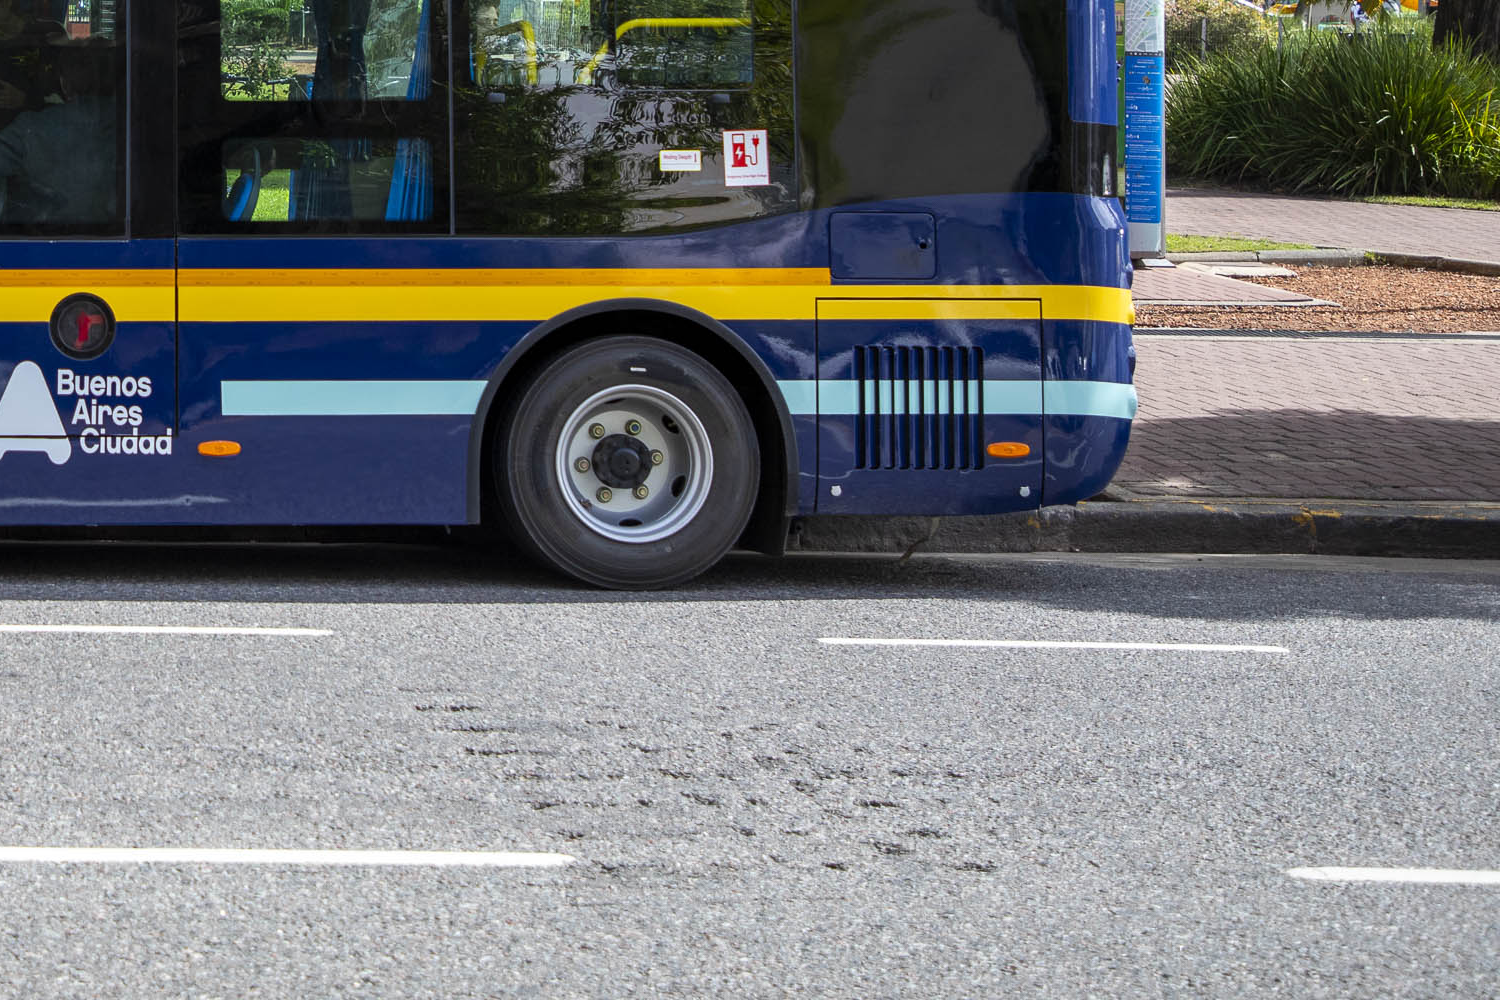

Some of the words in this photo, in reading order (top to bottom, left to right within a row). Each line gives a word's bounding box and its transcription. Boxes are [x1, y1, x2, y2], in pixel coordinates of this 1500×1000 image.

[57, 368, 152, 397] Buenos
[71, 399, 143, 425] Aires
[79, 427, 173, 455] Ciudad
